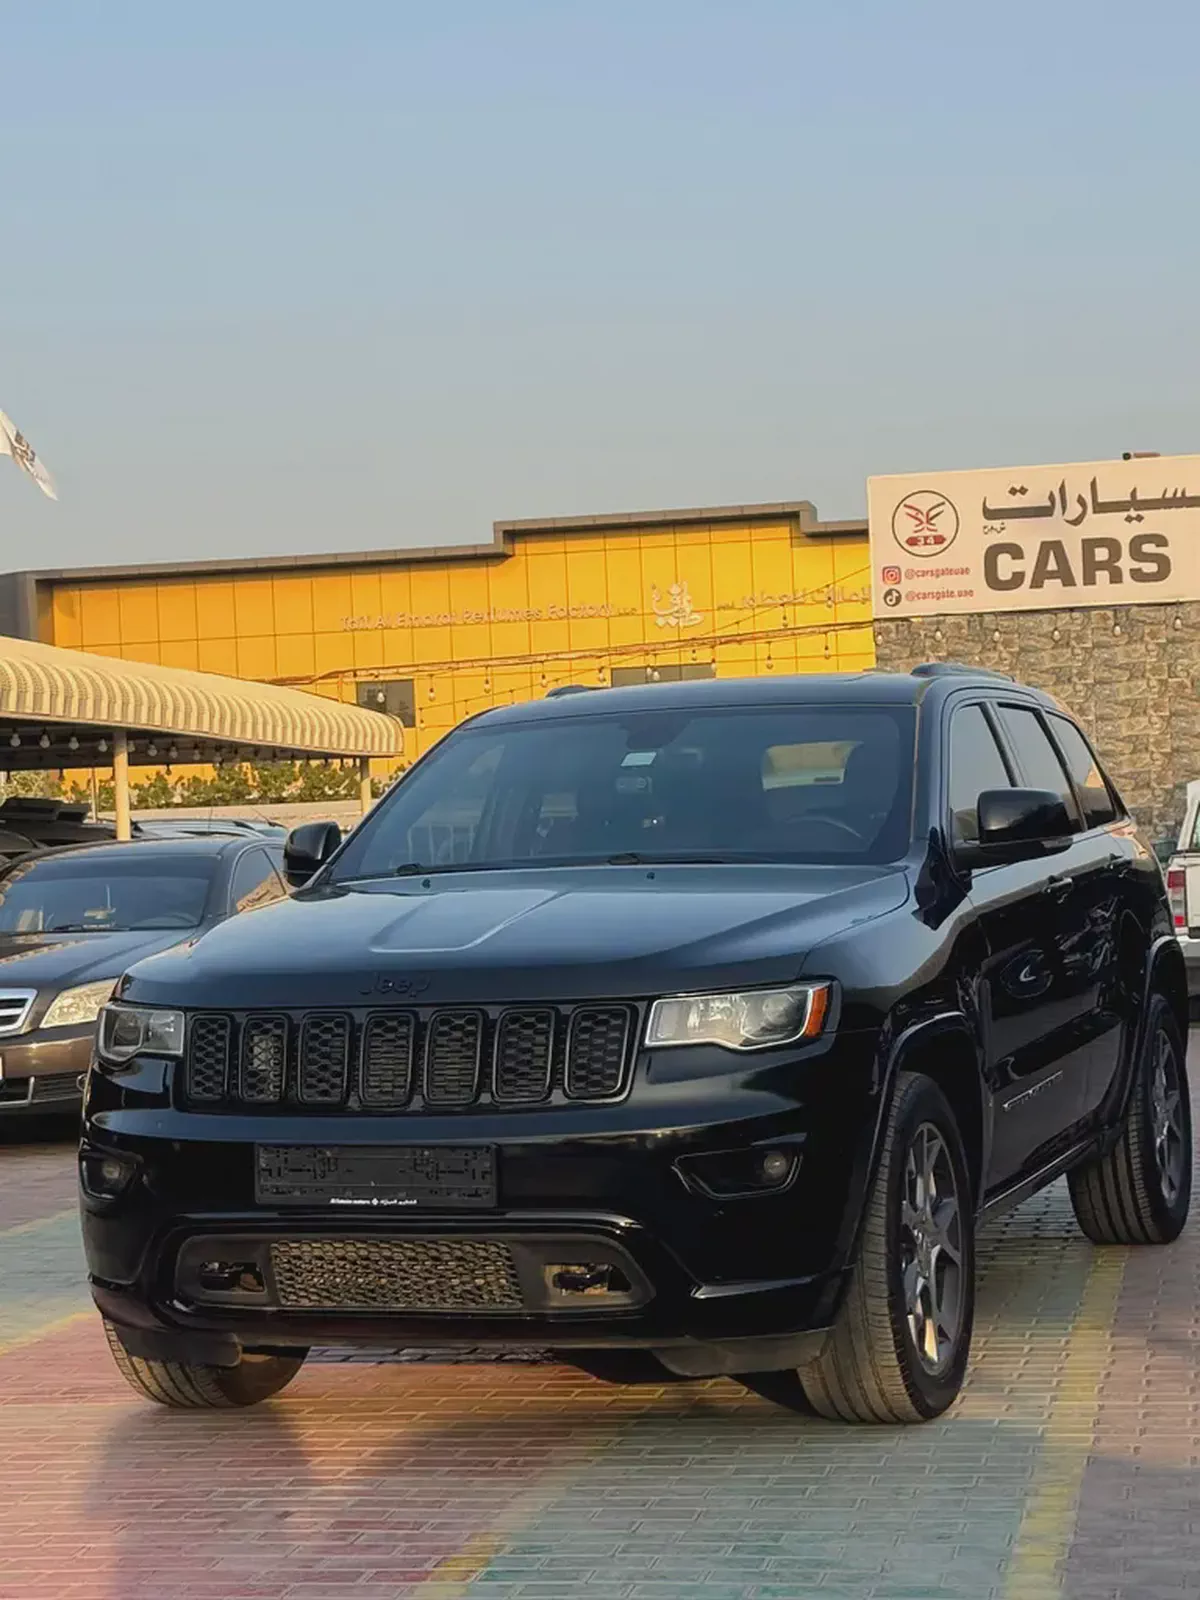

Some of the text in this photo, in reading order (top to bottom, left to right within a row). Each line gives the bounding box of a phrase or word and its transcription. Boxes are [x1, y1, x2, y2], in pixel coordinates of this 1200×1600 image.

[905, 567, 971, 580] @carsgateuae
[983, 533, 1172, 591] CARS
[905, 588, 975, 602] @carsgate.uae
[462, 604, 543, 626] Perfumes
[547, 603, 613, 620] Factory
[357, 971, 432, 999] Jeep
